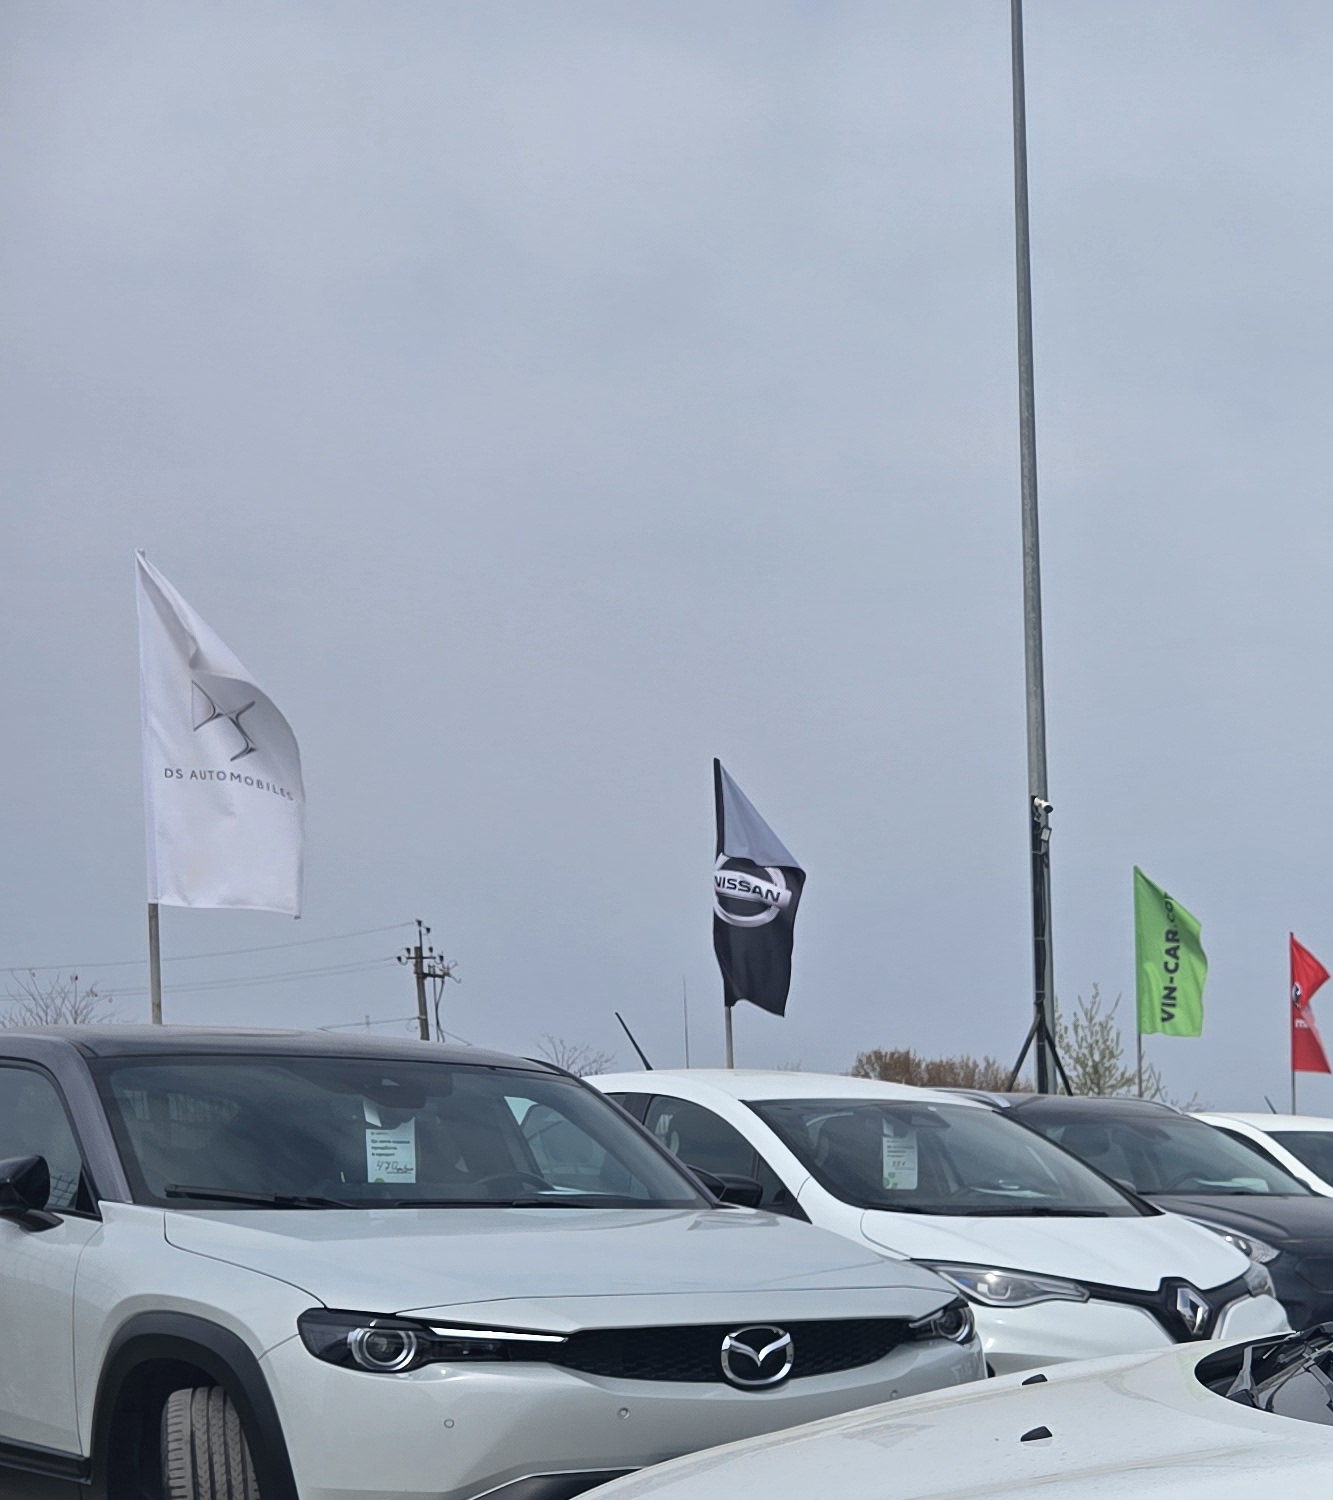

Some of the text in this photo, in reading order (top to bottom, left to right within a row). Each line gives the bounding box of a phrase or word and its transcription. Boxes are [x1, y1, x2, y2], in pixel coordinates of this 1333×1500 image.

[164, 767, 294, 802] DS AUTOMOBILES
[714, 875, 781, 903] NISSAN
